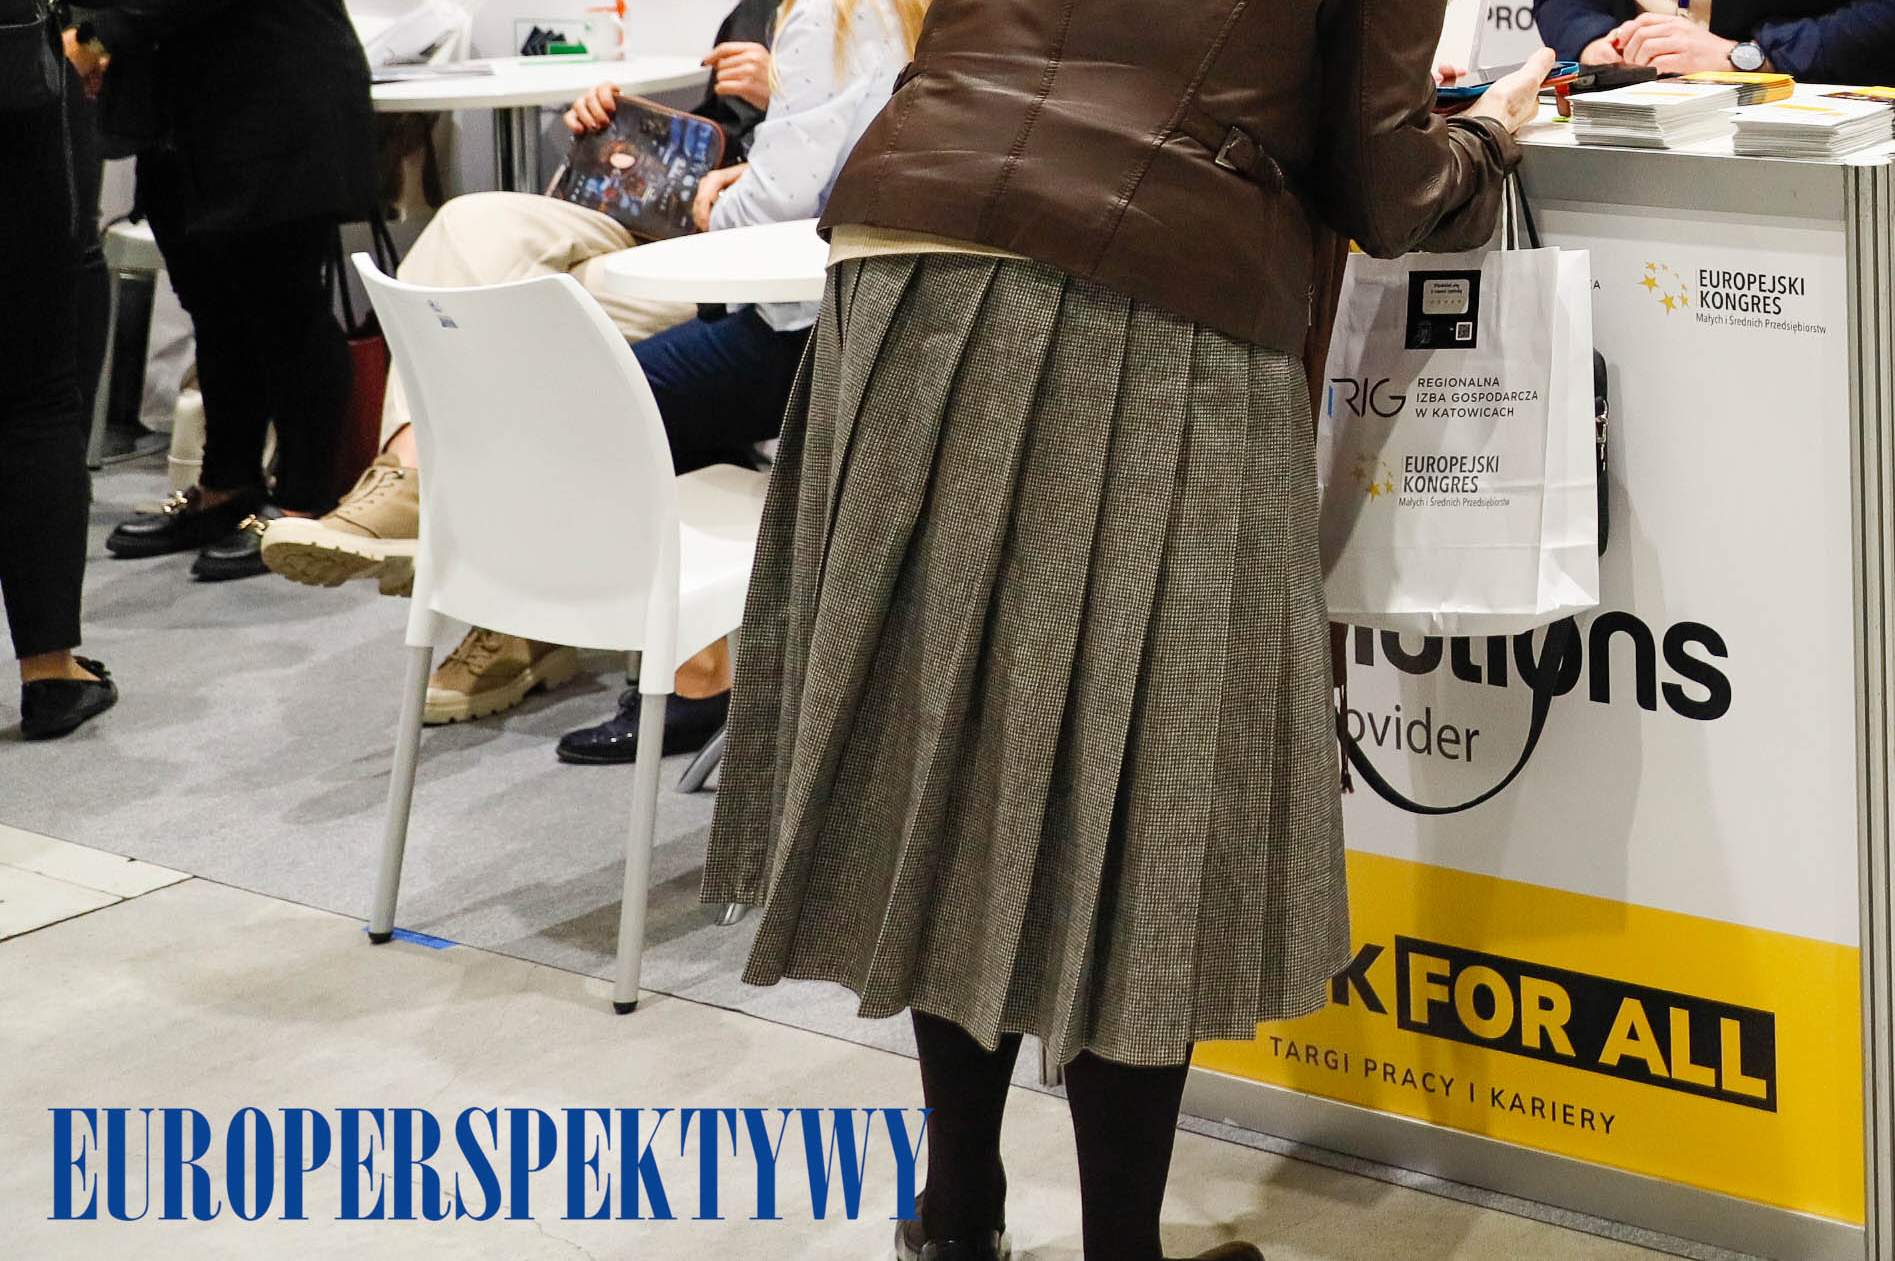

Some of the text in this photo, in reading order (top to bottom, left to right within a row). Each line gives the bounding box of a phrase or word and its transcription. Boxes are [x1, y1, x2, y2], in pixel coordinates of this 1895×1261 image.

[1699, 269, 1805, 296] EUROPEJSKI
[1700, 290, 1782, 315] KONGRES
[1695, 312, 1723, 327] Małych
[1729, 313, 1763, 328] Średnich
[1765, 318, 1827, 335] Przedsiębiorstw
[1417, 377, 1500, 388] REGIONALNA
[1328, 378, 1407, 419] RIG
[1416, 390, 1539, 404] IZBA GOSPODARCZA
[1415, 407, 1515, 418] W KATOWICACH
[1404, 455, 1500, 474] EUROPEJSKI
[1403, 475, 1479, 494] KONGRES
[1398, 497, 1425, 510] Małych
[1429, 496, 1461, 507] Średnich
[1346, 704, 1480, 763] ovider
[1407, 952, 1577, 1057] FOR
[1599, 996, 1767, 1100] ALL
[1270, 1037, 1617, 1135] TARGI PRACY I KARIERY
